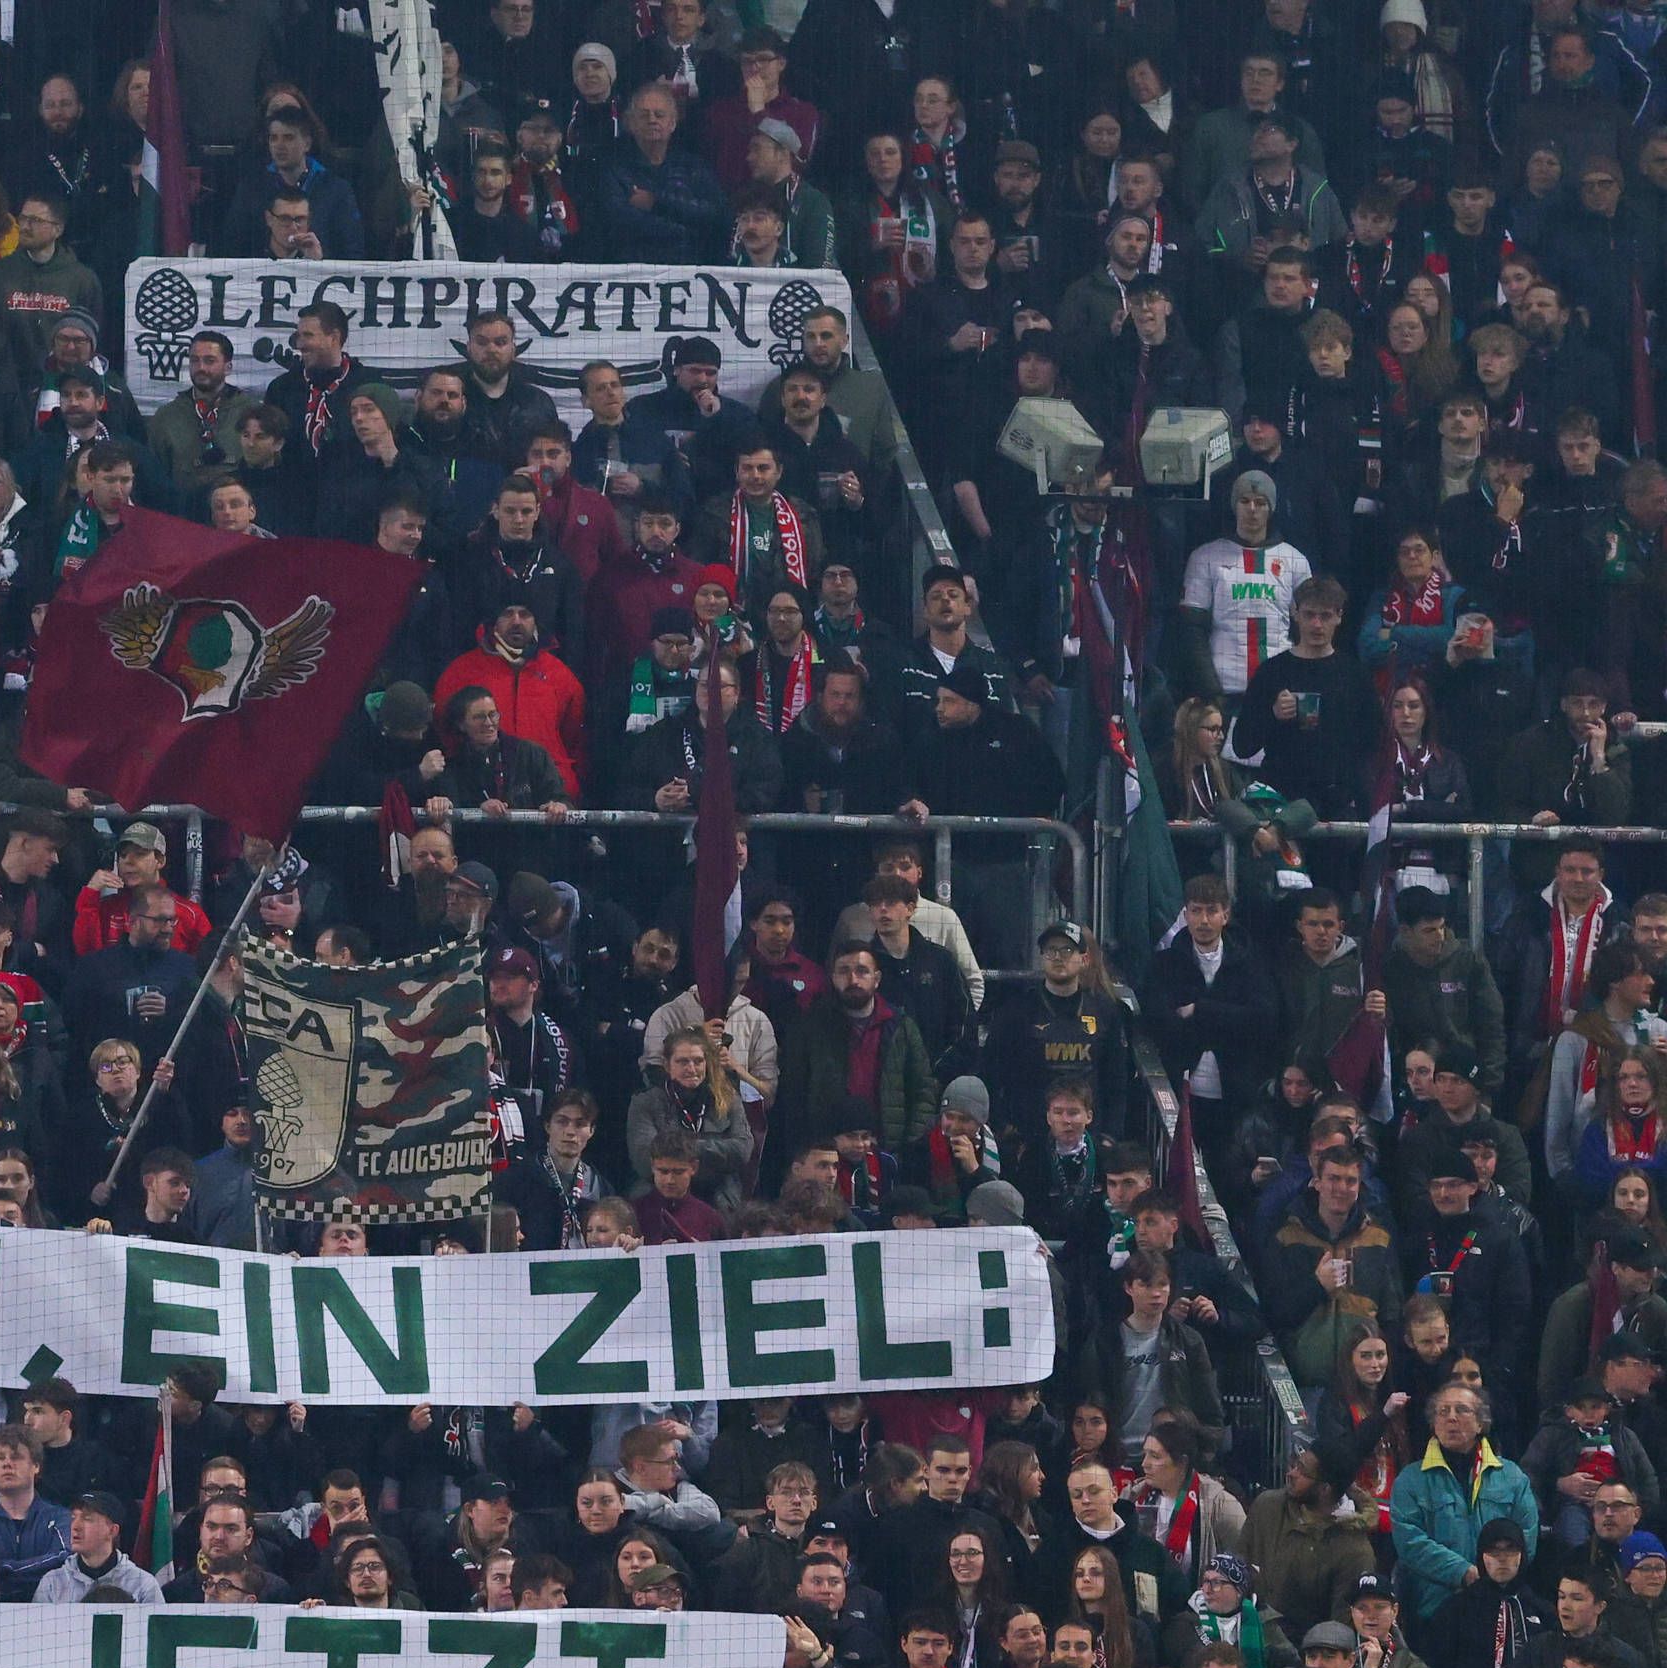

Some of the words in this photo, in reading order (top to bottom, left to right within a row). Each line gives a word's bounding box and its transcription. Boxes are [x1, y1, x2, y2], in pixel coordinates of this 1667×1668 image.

[204, 273, 768, 349] LECHPIRATEN
[1231, 582, 1276, 602] WWK
[1044, 1041, 1092, 1062] WWK
[358, 1151, 381, 1177] FC
[386, 1137, 492, 1176] AUGSBURG
[120, 1246, 431, 1395] EIN
[527, 1240, 1012, 1397] ZIEL:
